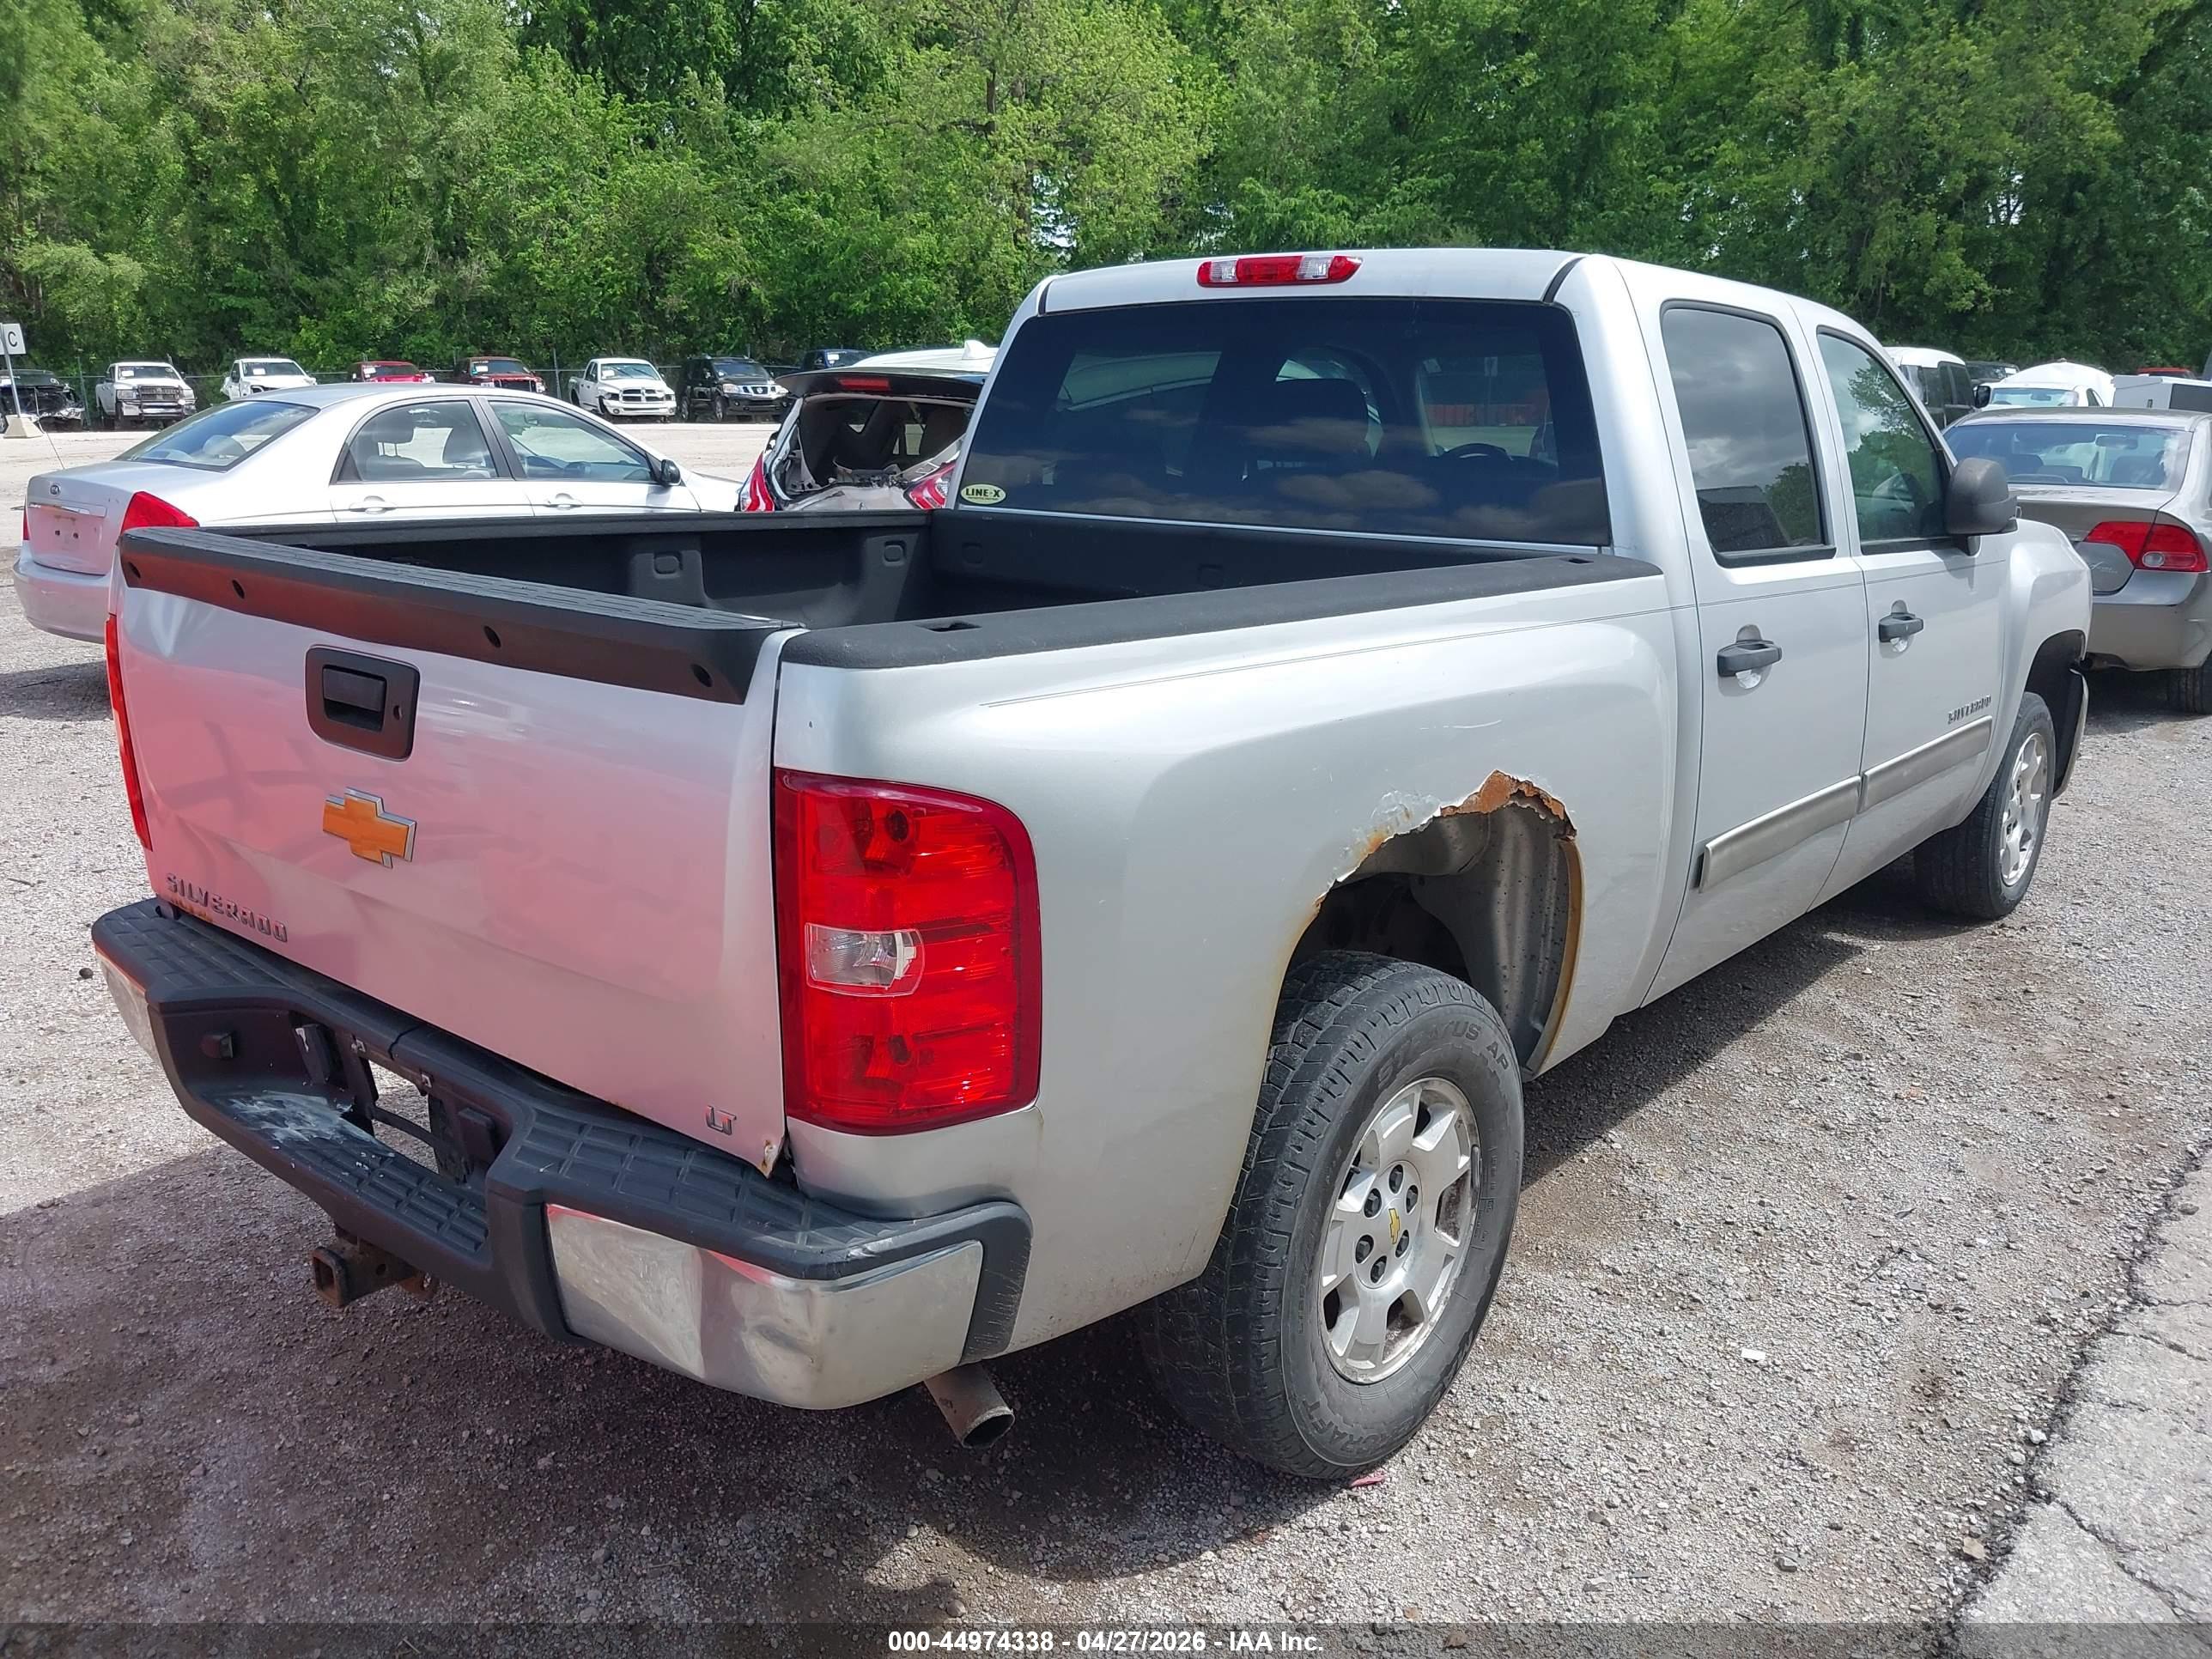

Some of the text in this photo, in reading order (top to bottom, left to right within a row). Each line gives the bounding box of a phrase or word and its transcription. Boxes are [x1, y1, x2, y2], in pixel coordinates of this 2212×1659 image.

[8, 331, 17, 347] C
[966, 489, 1000, 498] LINE-X
[167, 872, 289, 943] SILVERADO
[705, 1104, 737, 1135] LT
